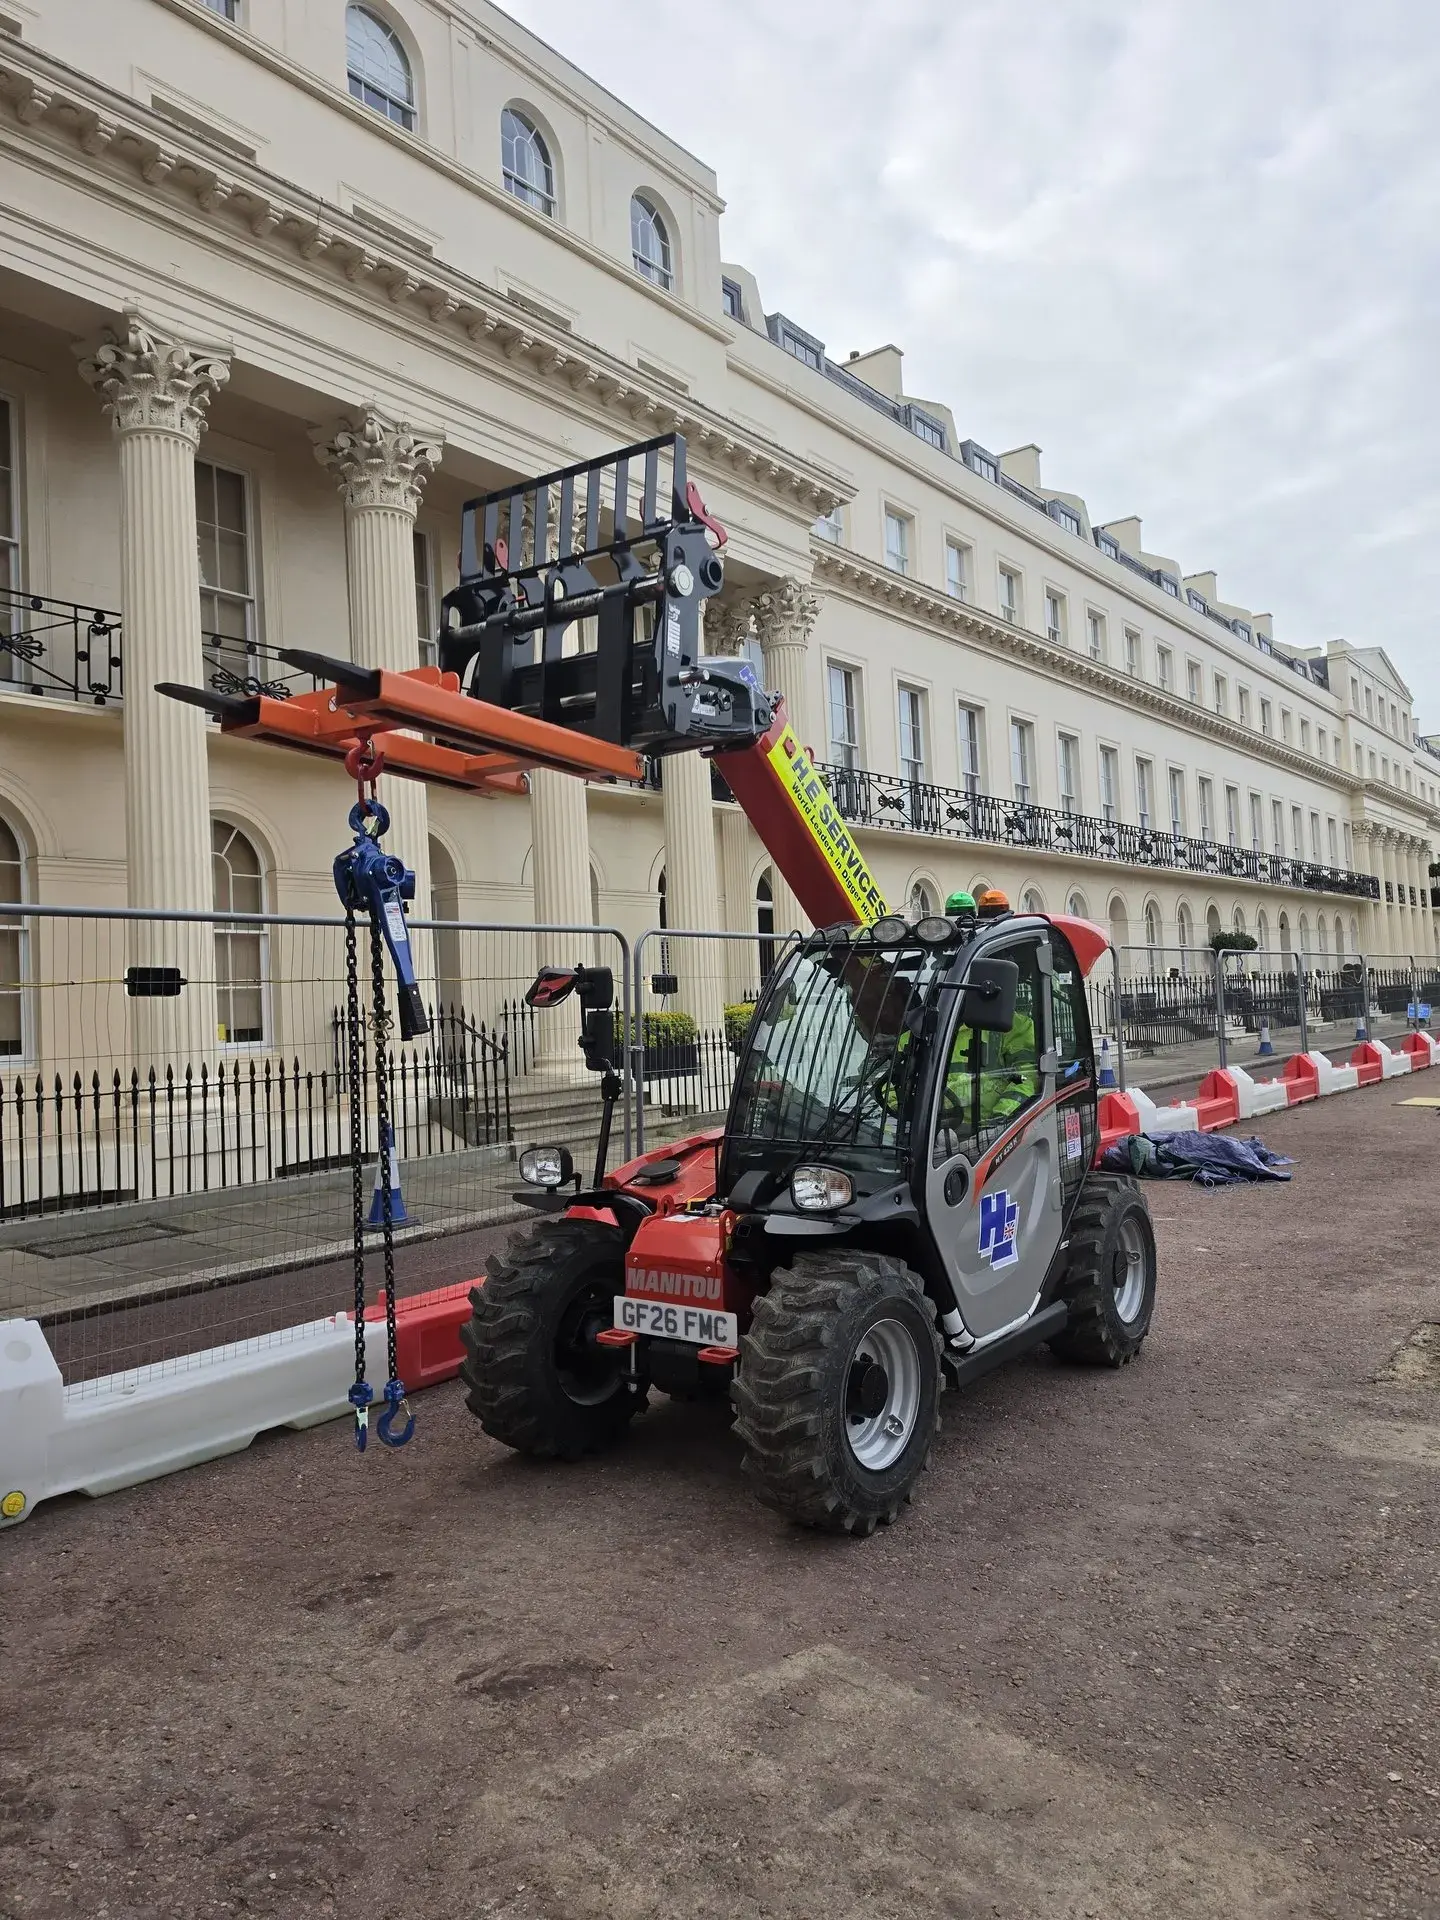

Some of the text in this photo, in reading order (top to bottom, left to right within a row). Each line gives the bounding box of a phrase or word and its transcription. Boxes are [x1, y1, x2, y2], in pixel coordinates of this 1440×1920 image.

[792, 756, 887, 918] H.E. SERVICES
[792, 782, 874, 924] World Leaders in Digger Hire
[622, 1301, 728, 1343] GF26 FMC
[627, 1267, 721, 1300] MANITOU
